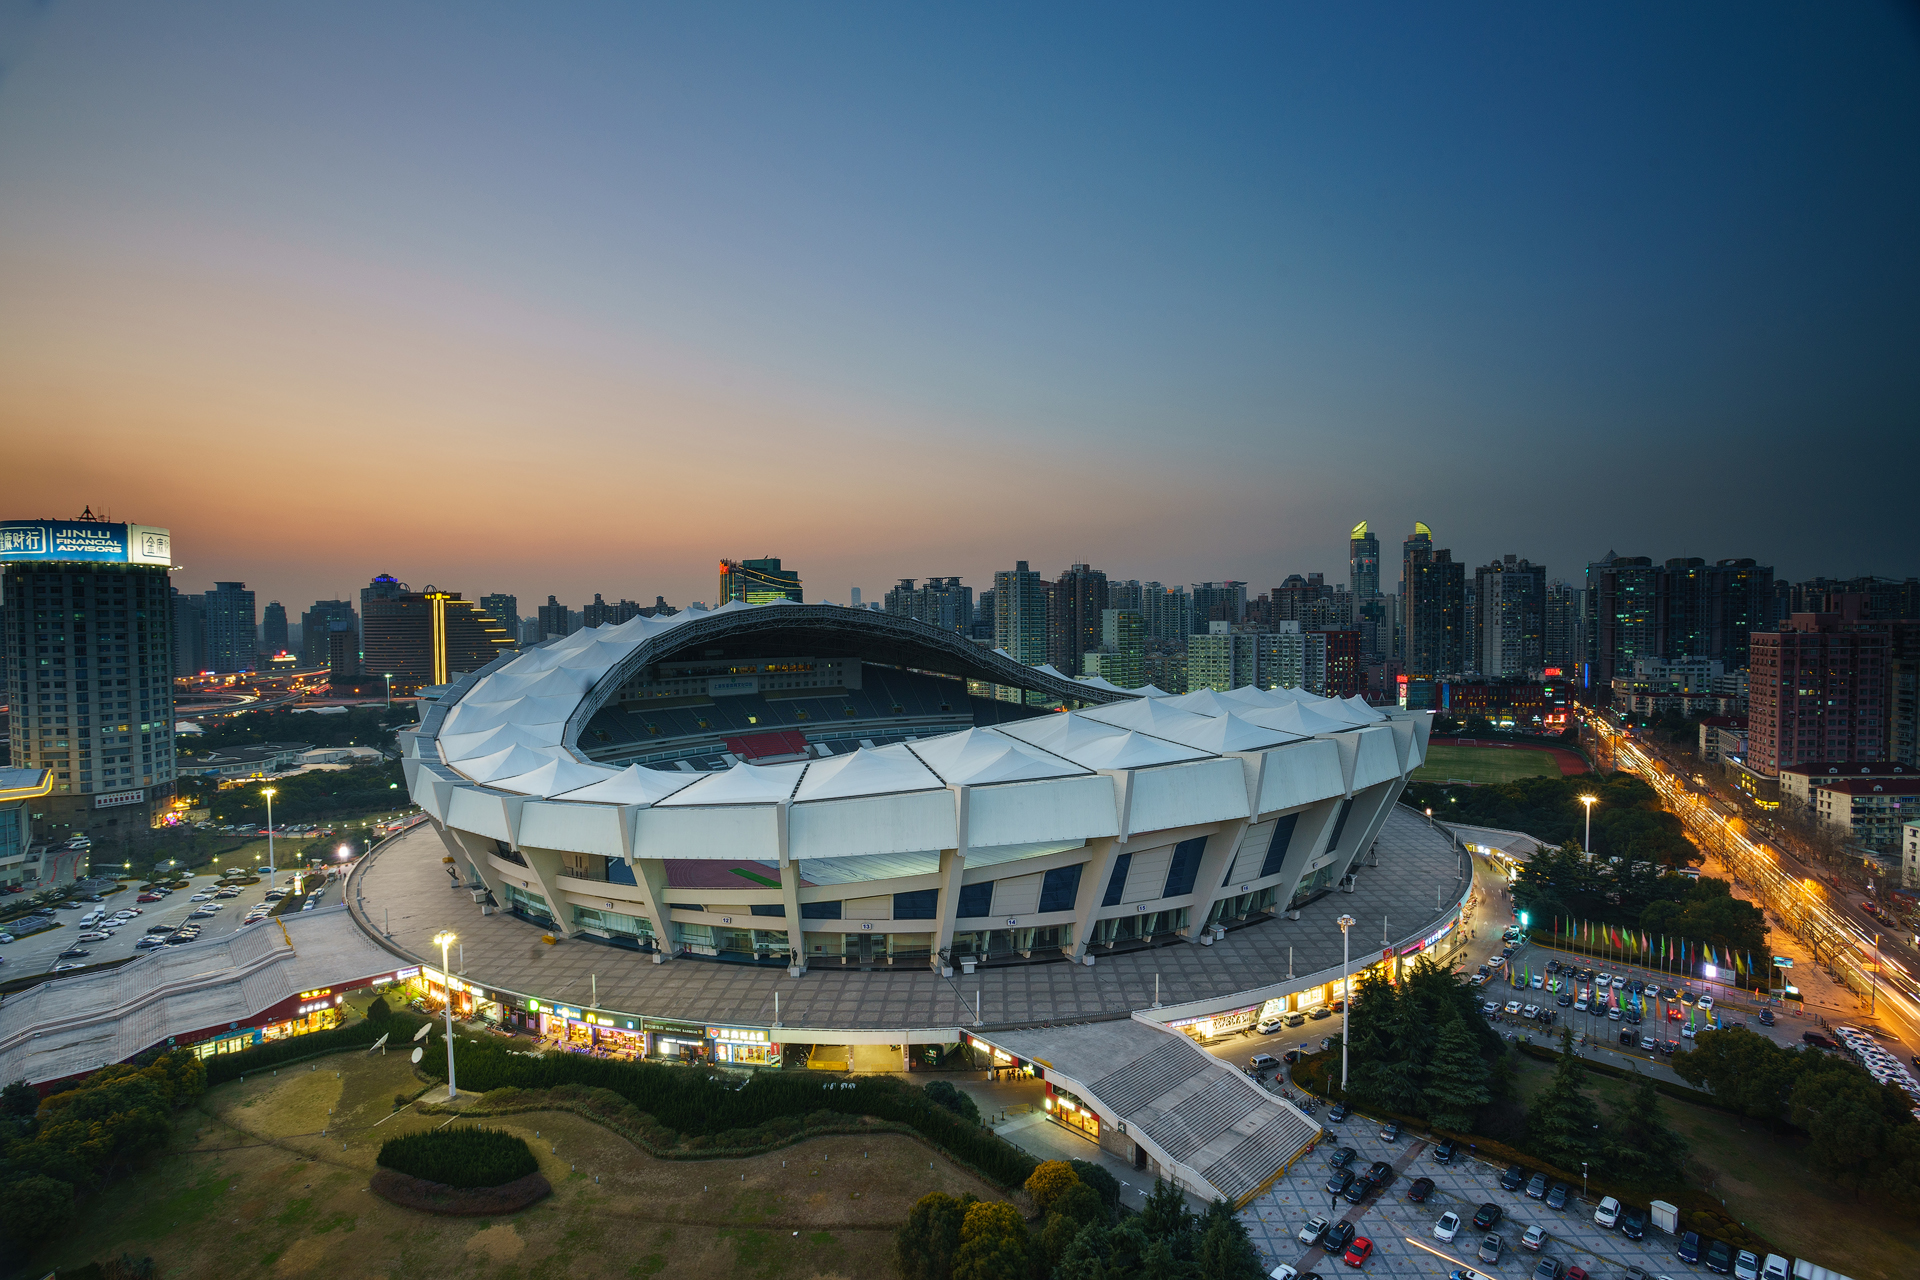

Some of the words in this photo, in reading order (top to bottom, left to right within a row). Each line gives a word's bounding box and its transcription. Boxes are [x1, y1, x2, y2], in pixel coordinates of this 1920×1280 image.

[56, 529, 111, 539] JINLU
[56, 538, 122, 547] FINANCIAL
[57, 545, 122, 553] ADVISORS
[168, 1036, 175, 1045] 5
[1118, 1124, 1125, 1132] 4
